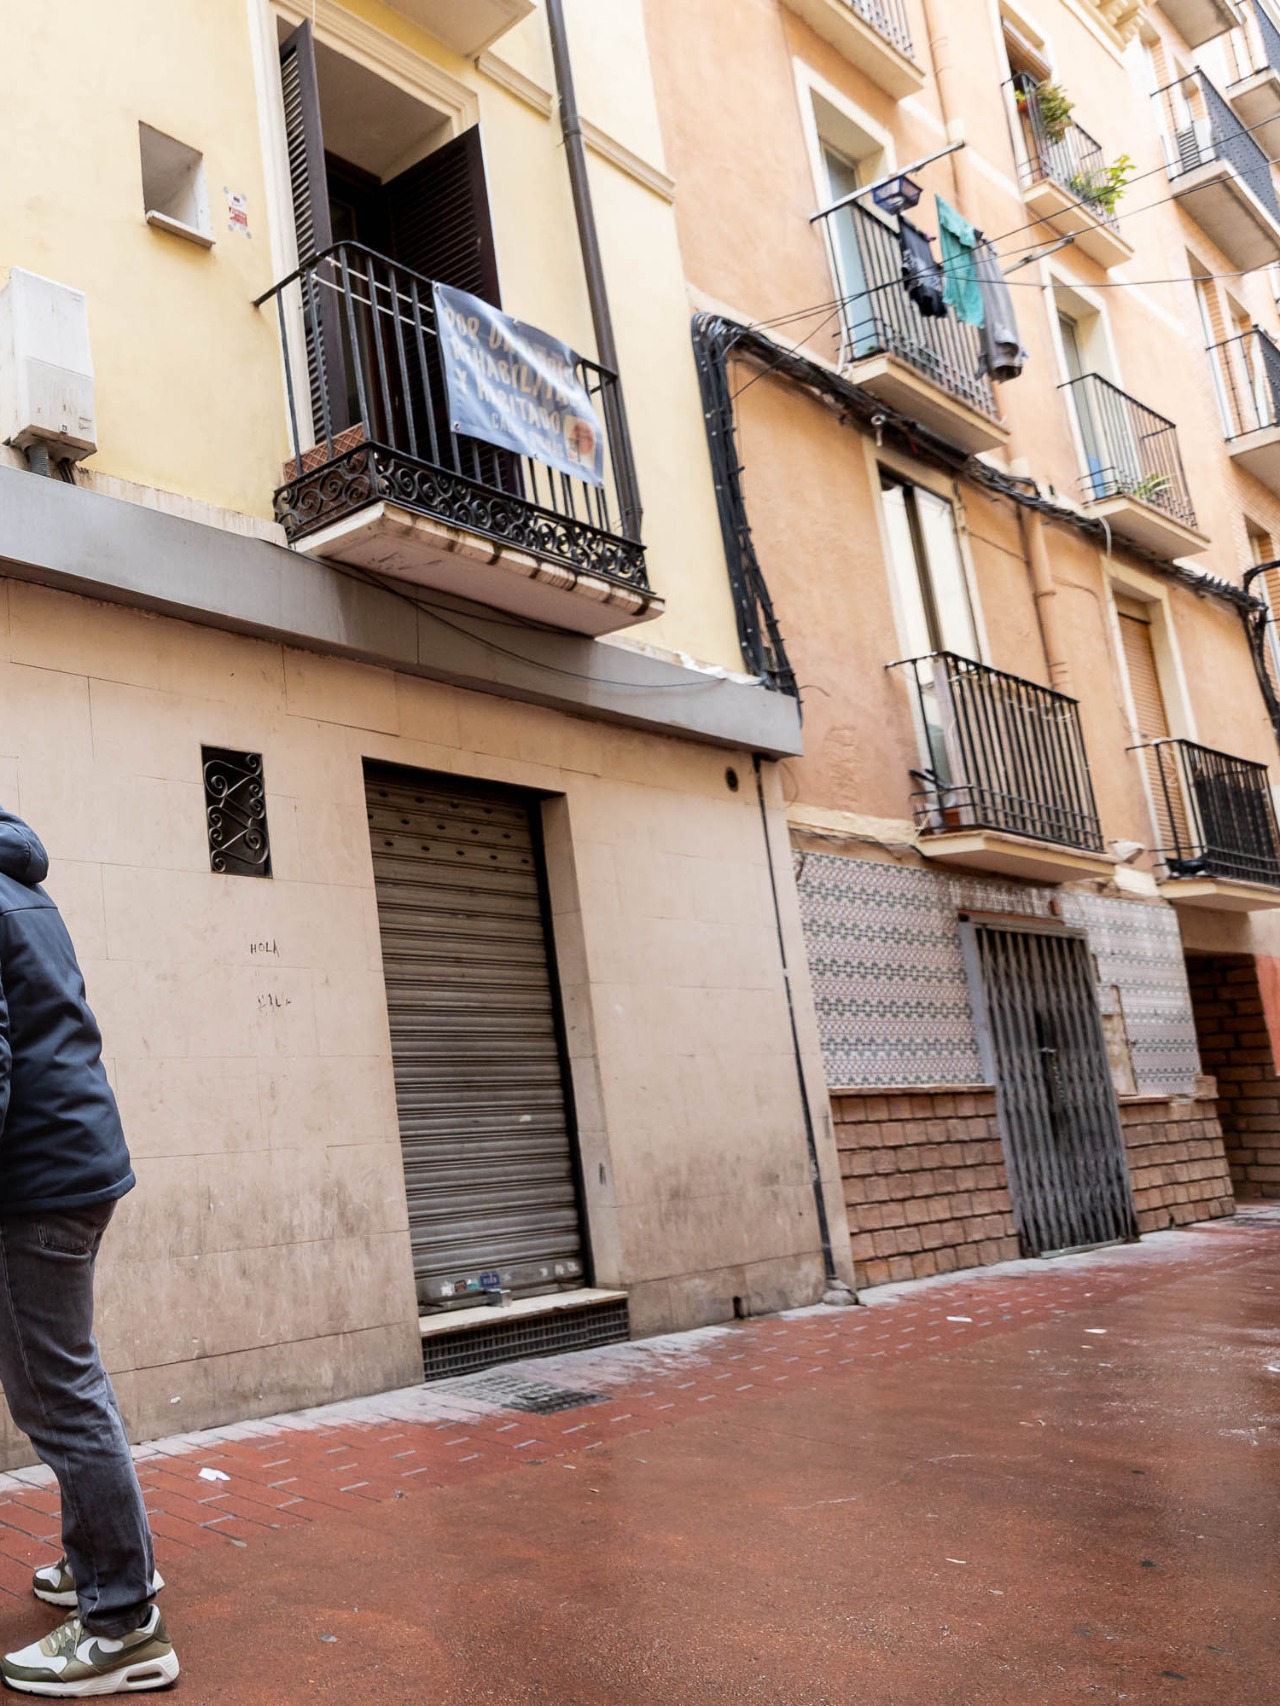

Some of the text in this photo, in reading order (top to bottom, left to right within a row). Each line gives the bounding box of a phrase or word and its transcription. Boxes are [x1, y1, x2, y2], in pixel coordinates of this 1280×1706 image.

[443, 306, 480, 344] POR
[454, 367, 468, 395] Y
[250, 938, 280, 958] HOLA
